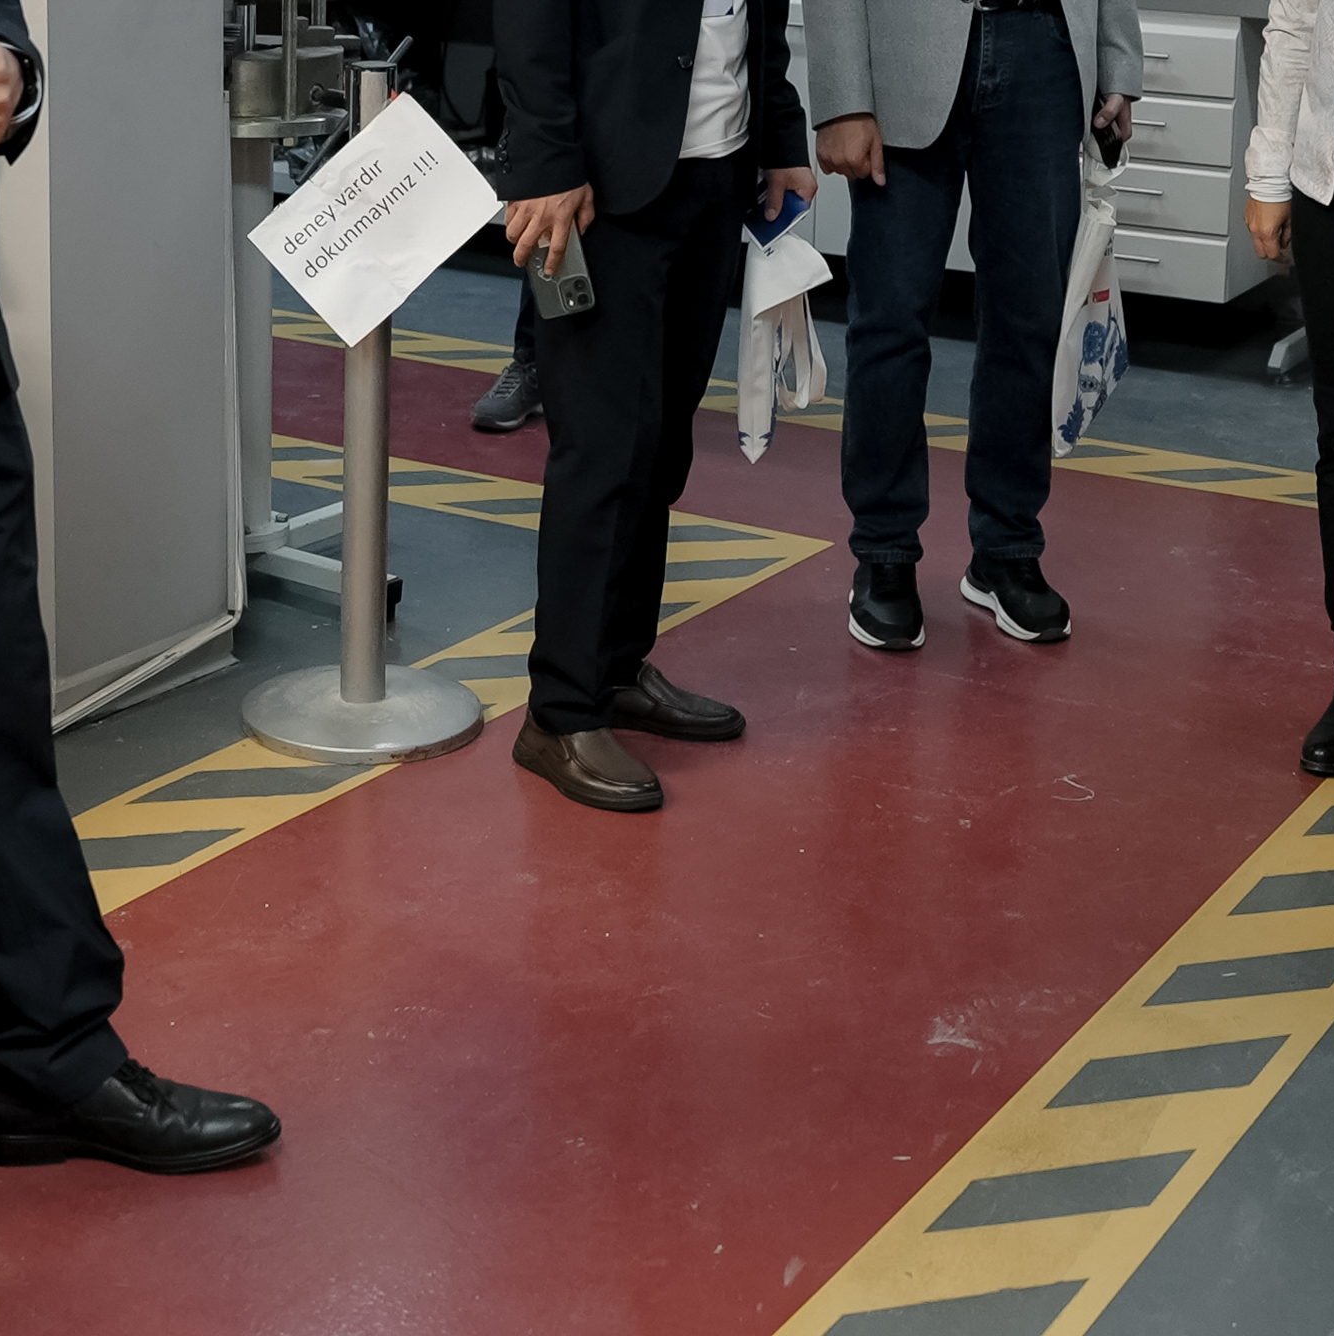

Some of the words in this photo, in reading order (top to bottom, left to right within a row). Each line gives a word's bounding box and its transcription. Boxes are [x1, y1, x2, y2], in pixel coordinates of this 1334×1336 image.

[284, 204, 337, 255] deney
[335, 159, 383, 207] vardır
[304, 173, 417, 278] dokunmayınız
[413, 150, 439, 176] !!!
